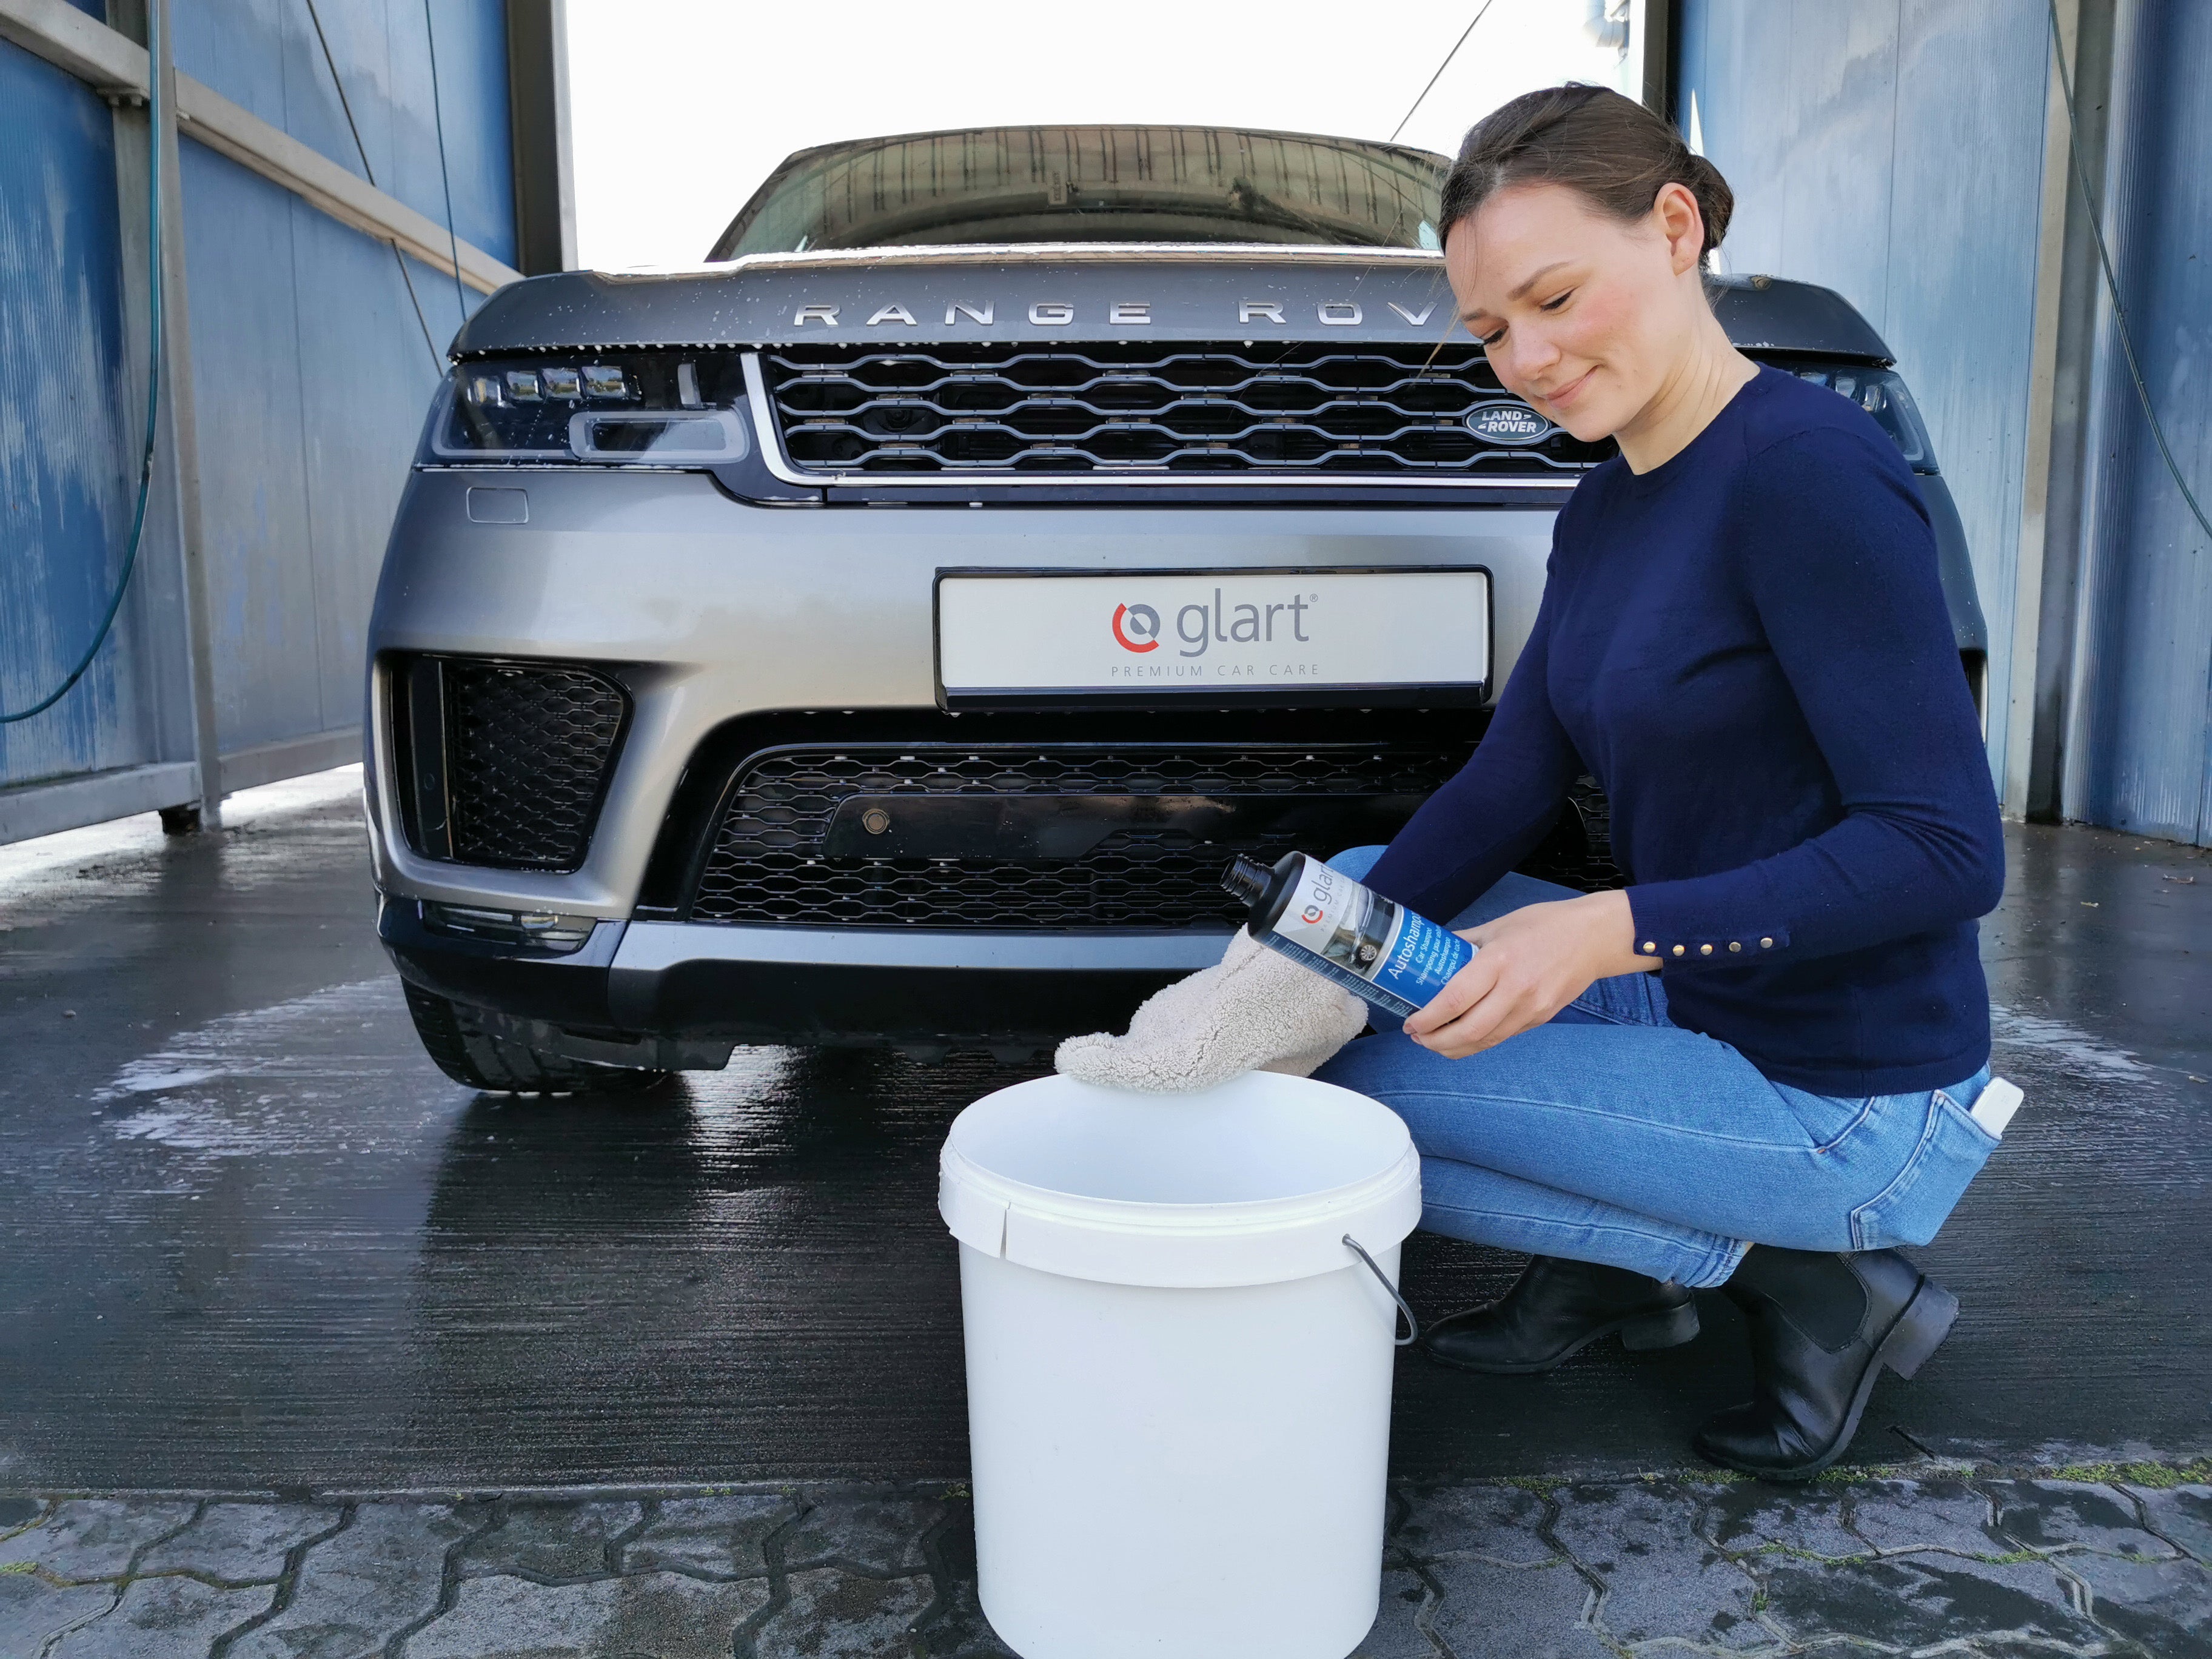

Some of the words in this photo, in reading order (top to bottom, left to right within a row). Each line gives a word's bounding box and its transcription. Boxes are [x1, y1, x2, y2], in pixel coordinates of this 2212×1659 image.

[793, 301, 1151, 326] RANGE
[1239, 300, 1438, 326] ROV
[1482, 411, 1522, 421] LAND
[1487, 421, 1537, 433] ROVER
[1111, 665, 1203, 677] PREMIUM
[1218, 665, 1255, 677] CAR
[1270, 664, 1319, 676] CARE
[1311, 863, 1334, 905] glart
[1388, 911, 1425, 980] Autoshampo
[1415, 951, 1426, 964] Car
[1421, 927, 1432, 951] Shampoo
